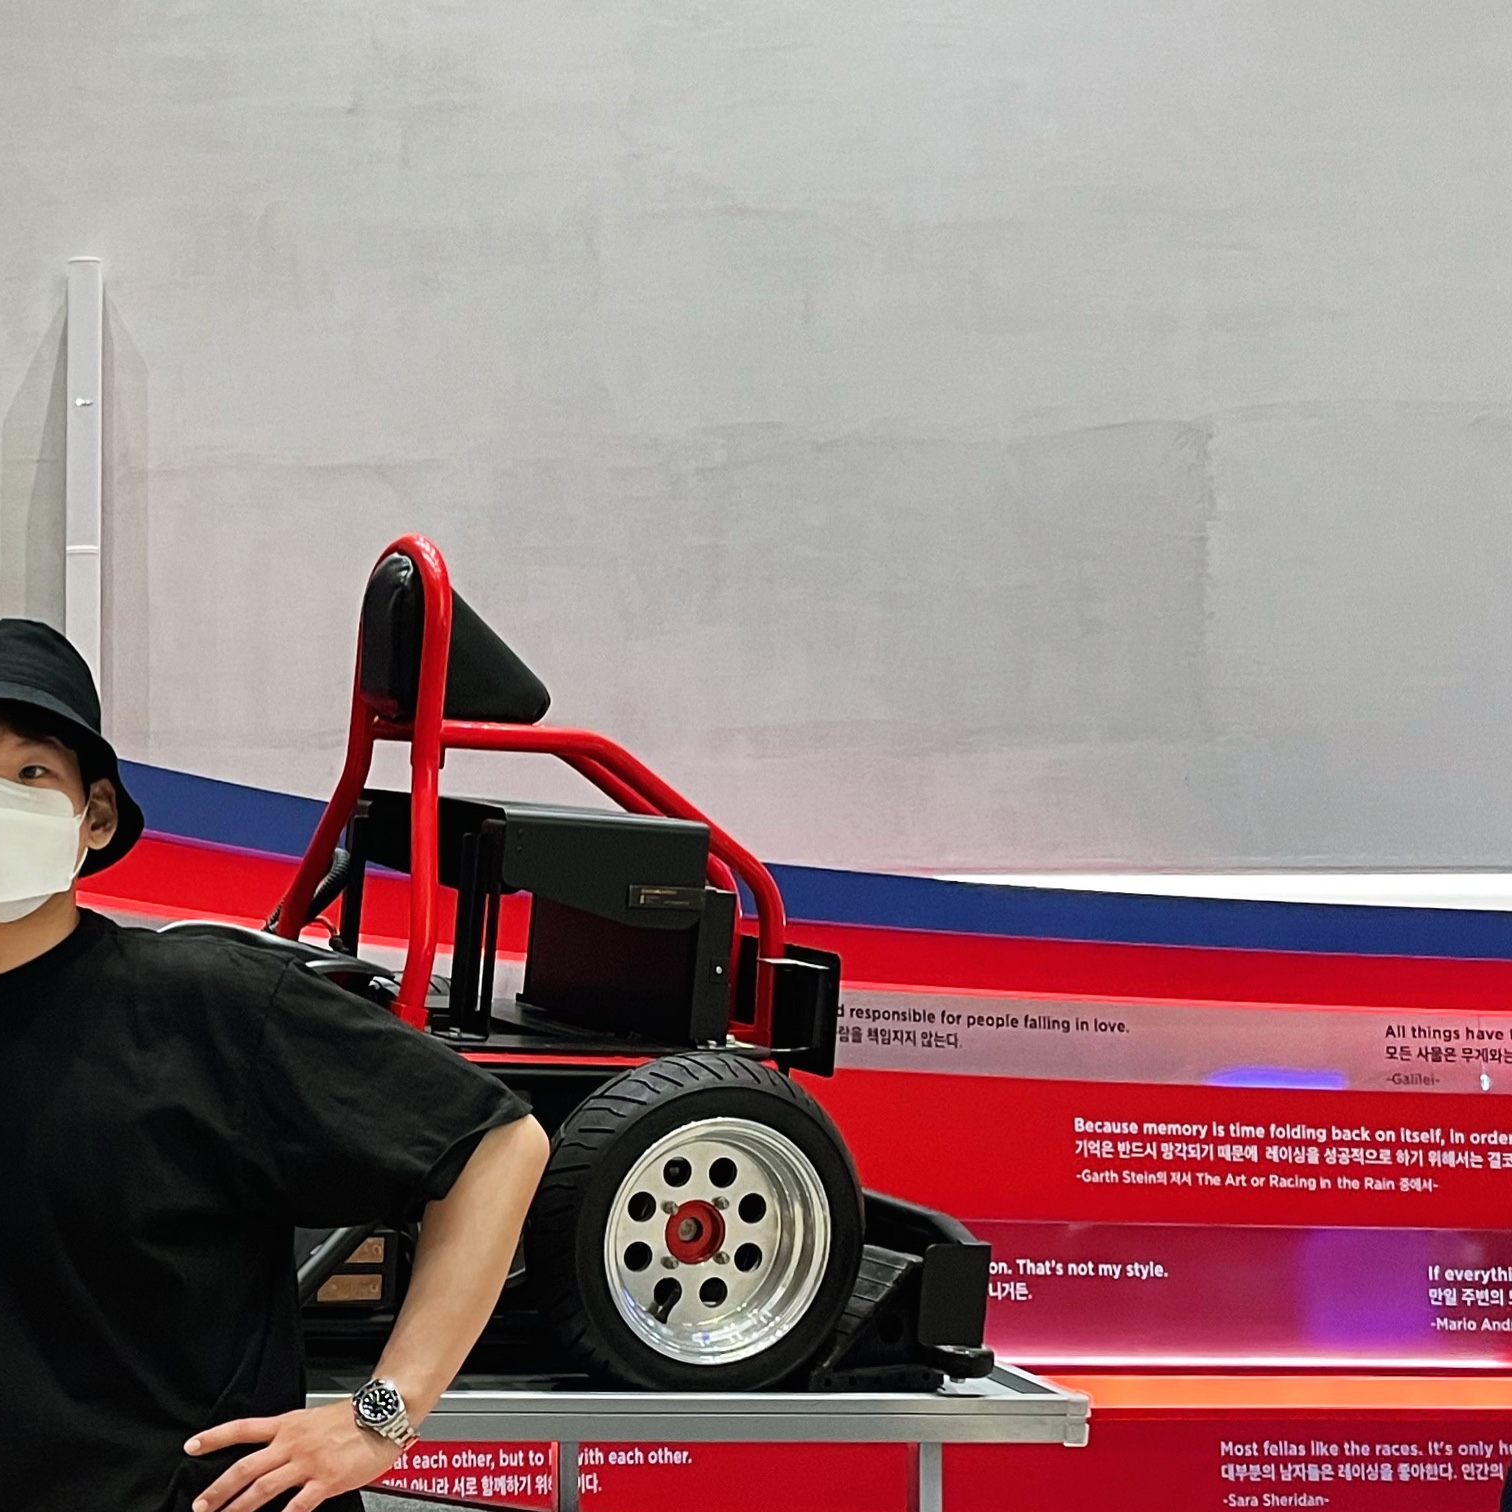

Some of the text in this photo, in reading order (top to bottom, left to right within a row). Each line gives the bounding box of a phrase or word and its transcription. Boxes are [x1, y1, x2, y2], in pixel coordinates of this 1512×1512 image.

[850, 1007, 936, 1024] responsible
[941, 1010, 962, 1025] for
[967, 1014, 1019, 1029] people
[1024, 1014, 1071, 1034] falling
[1076, 1017, 1089, 1032] in
[1094, 1018, 1130, 1033] love.
[838, 1026, 963, 1049] 람을 책임지지 않는다.
[1385, 1025, 1405, 1039] All
[1411, 1025, 1460, 1043] things
[1466, 1027, 1504, 1041] have
[1385, 1046, 1412, 1062] 모든
[1417, 1046, 1457, 1063] 사물은
[1074, 1117, 1138, 1134] Because
[1143, 1121, 1208, 1140] memory
[1212, 1122, 1225, 1137] is
[1229, 1122, 1265, 1138] time
[1269, 1123, 1327, 1143] folding
[1331, 1125, 1371, 1142] back
[1374, 1129, 1396, 1143] on
[1400, 1127, 1445, 1146] itself,
[1449, 1128, 1465, 1144] in
[1075, 1140, 1114, 1158] 기억은
[1117, 1141, 1157, 1160] 반드시
[1161, 1142, 1214, 1161] 망각되기
[1217, 1144, 1258, 1163] 때문에
[1265, 1145, 1320, 1165] 레이싱을
[1323, 1147, 1393, 1166] 성공적으로
[1396, 1149, 1424, 1167] 하기
[1428, 1150, 1484, 1169] 위해서는
[1076, 1168, 1119, 1183] -Garth
[1122, 1170, 1167, 1185] Stein의
[1170, 1171, 1192, 1186] 저서
[1196, 1172, 1221, 1186] The
[1225, 1173, 1247, 1187] Art
[1250, 1176, 1266, 1187] or
[1269, 1174, 1316, 1191] Racing
[1319, 1176, 1332, 1189] in
[1337, 1176, 1360, 1190] the
[1364, 1176, 1395, 1190] Rain
[1016, 1259, 1064, 1276] That's
[1068, 1261, 1095, 1276] not
[1099, 1263, 1122, 1280] my
[1126, 1261, 1169, 1280] style.
[1428, 1265, 1440, 1280] If
[1428, 1287, 1458, 1306] 만일
[1461, 1288, 1504, 1307] 주변의
[1431, 1317, 1512, 1332] -Mario And
[412, 1450, 448, 1469] each
[451, 1450, 495, 1470] other,
[499, 1449, 524, 1467] but
[528, 1450, 544, 1466] to
[608, 1447, 644, 1465] each
[647, 1446, 692, 1464] other.
[1220, 1441, 1259, 1457] Most
[1263, 1440, 1306, 1456] fellas
[1310, 1440, 1339, 1456] like
[1344, 1440, 1370, 1457] the
[1375, 1444, 1423, 1456] races.
[1428, 1441, 1453, 1456] It's
[1458, 1441, 1494, 1459] only
[1221, 1462, 1504, 1481] 대부분의 남자들은 레이싱을 좋아한다. 인간의
[452, 1476, 478, 1497] 서로
[481, 1474, 532, 1497] 함께하기
[1223, 1492, 1330, 1507] -Sara Sheridan-
